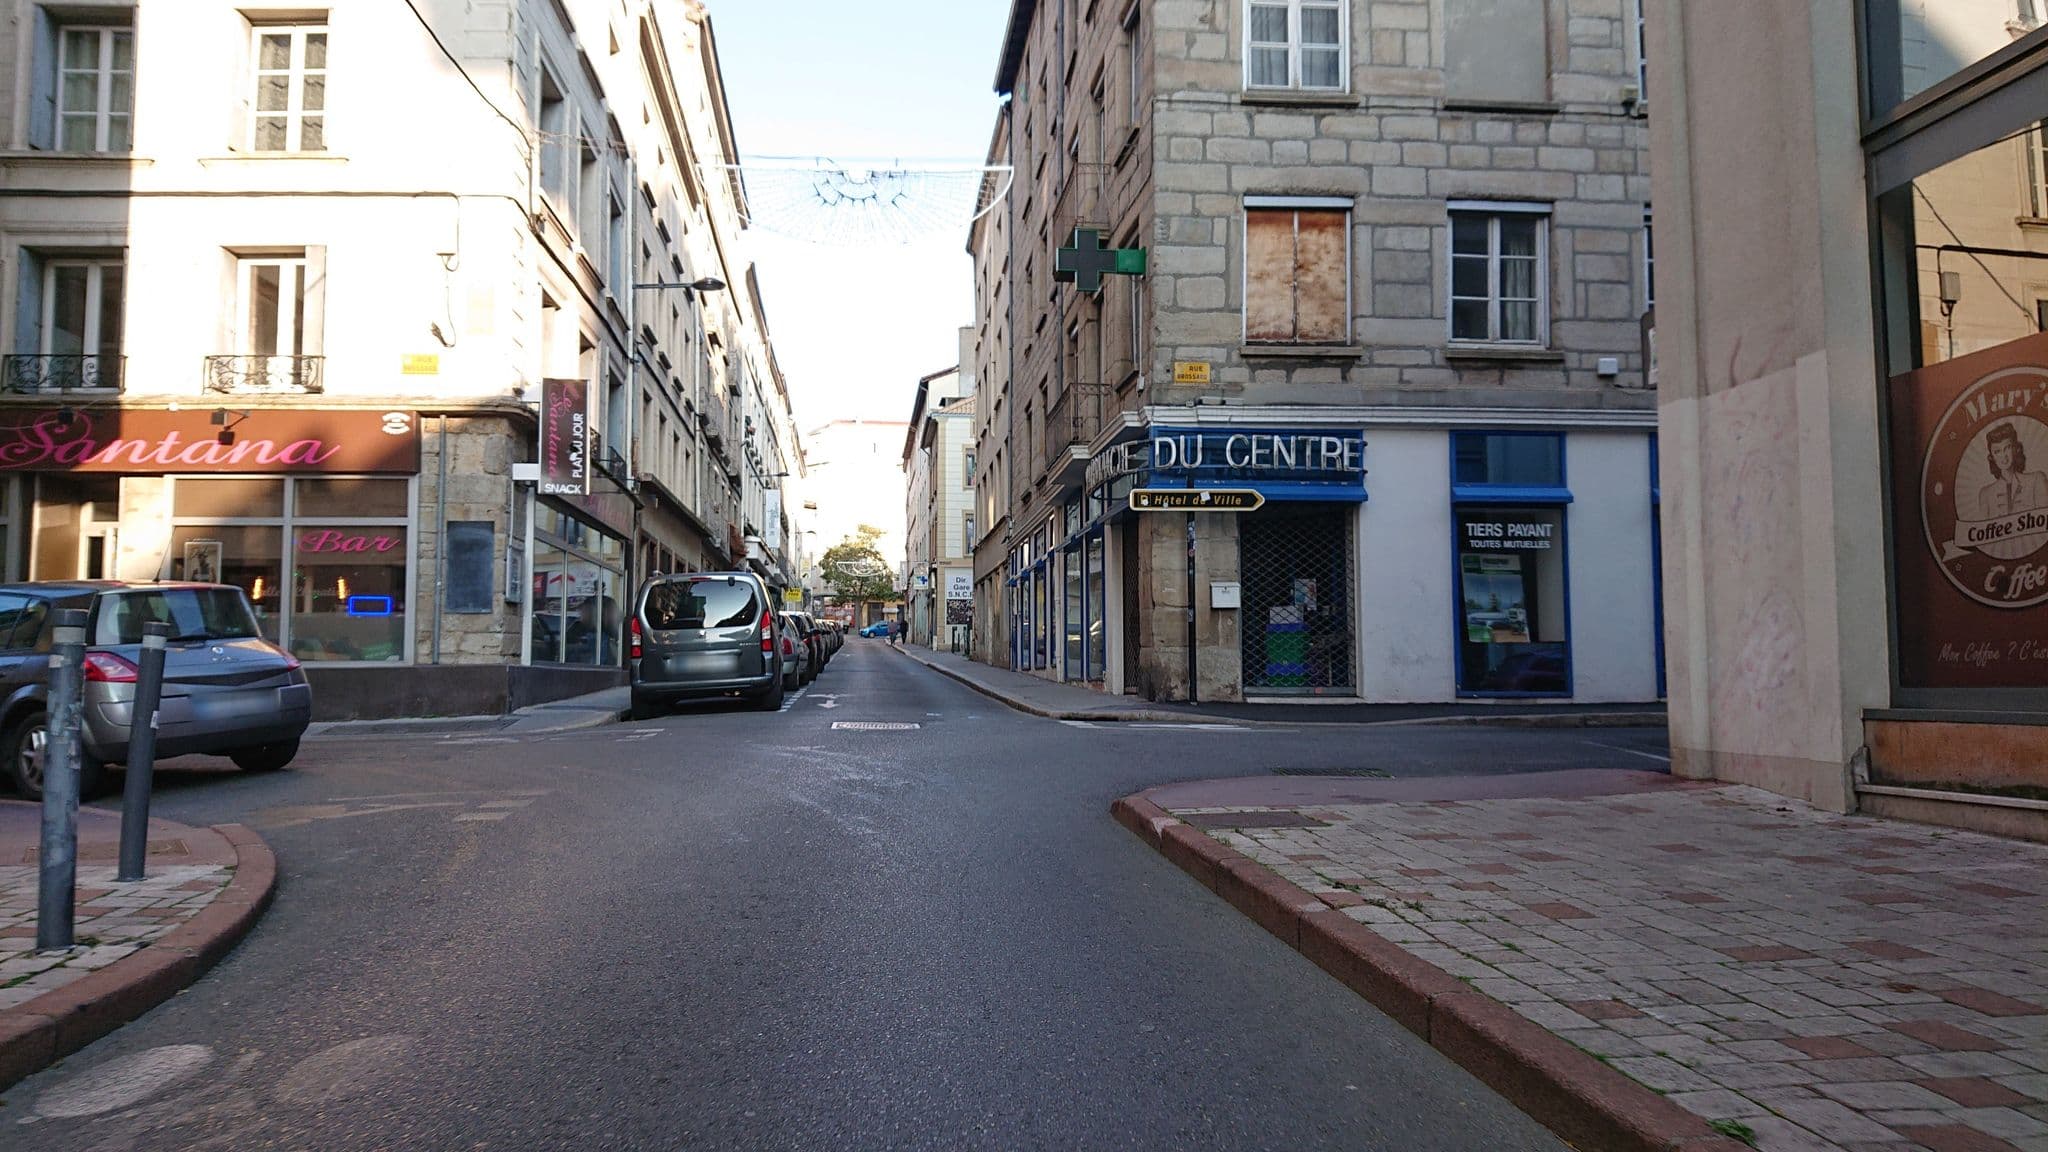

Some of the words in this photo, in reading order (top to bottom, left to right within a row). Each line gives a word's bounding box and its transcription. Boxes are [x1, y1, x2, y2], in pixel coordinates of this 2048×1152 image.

[548, 388, 564, 478] Santana
[572, 413, 583, 439] JOUR
[0, 409, 341, 468] Santana
[1155, 434, 1202, 469] DU
[1226, 434, 1361, 472] CENTRE
[544, 483, 581, 495] SNACK
[1154, 494, 1186, 506] Hôtel
[1214, 495, 1242, 505] Ville
[1466, 523, 1503, 537] TIERS
[1508, 523, 1553, 537] PAYANT
[1968, 521, 2012, 541] Coffee
[2017, 513, 2048, 531] Sho
[299, 530, 400, 552] Bar
[1470, 540, 1501, 548] TOUTES
[1504, 540, 1551, 549] MUTUELLES
[953, 583, 970, 591] Gare
[1964, 642, 2000, 666] Coffee
